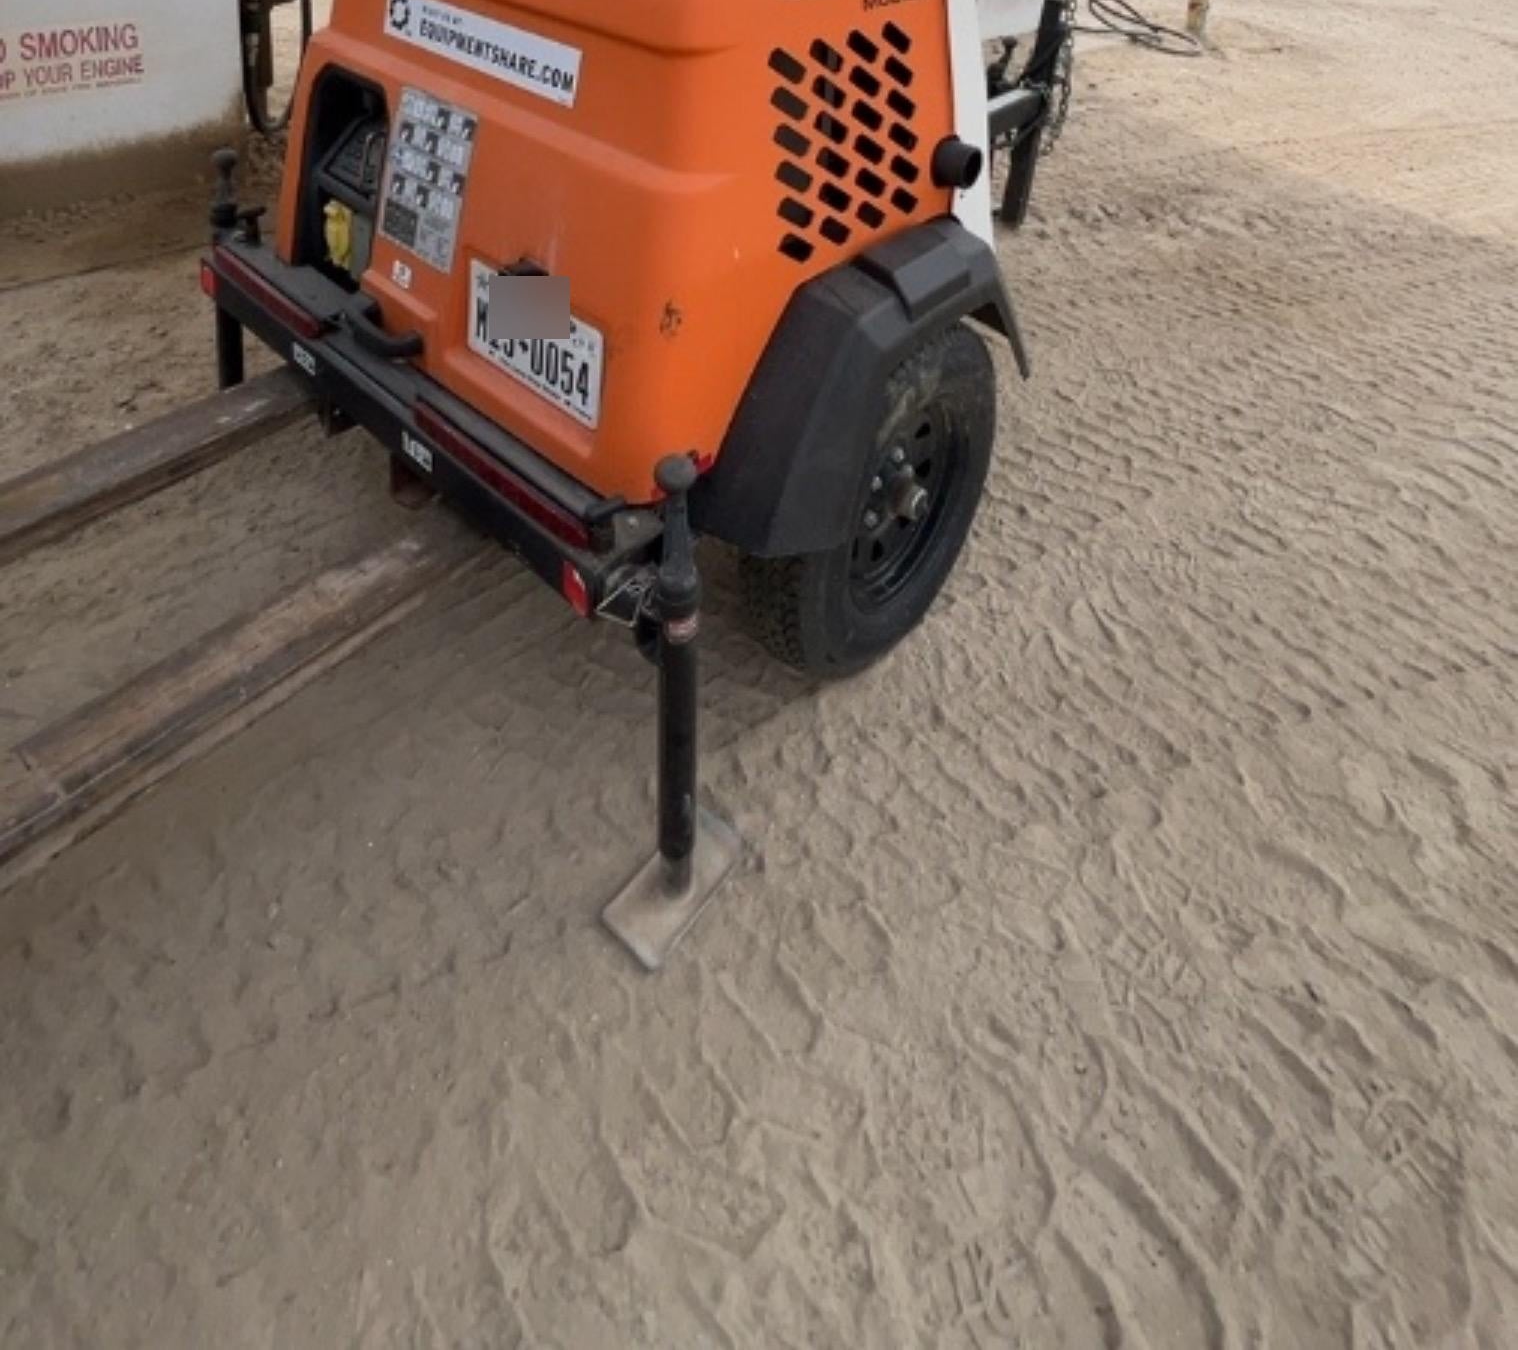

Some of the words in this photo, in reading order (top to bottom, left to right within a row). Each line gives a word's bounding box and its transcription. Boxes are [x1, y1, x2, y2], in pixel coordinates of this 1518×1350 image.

[20, 23, 138, 61] SMOKING
[419, 18, 574, 91] EQUIPMENTSHARE.COM
[23, 62, 73, 88] YOUR
[80, 54, 144, 81] ENGINE
